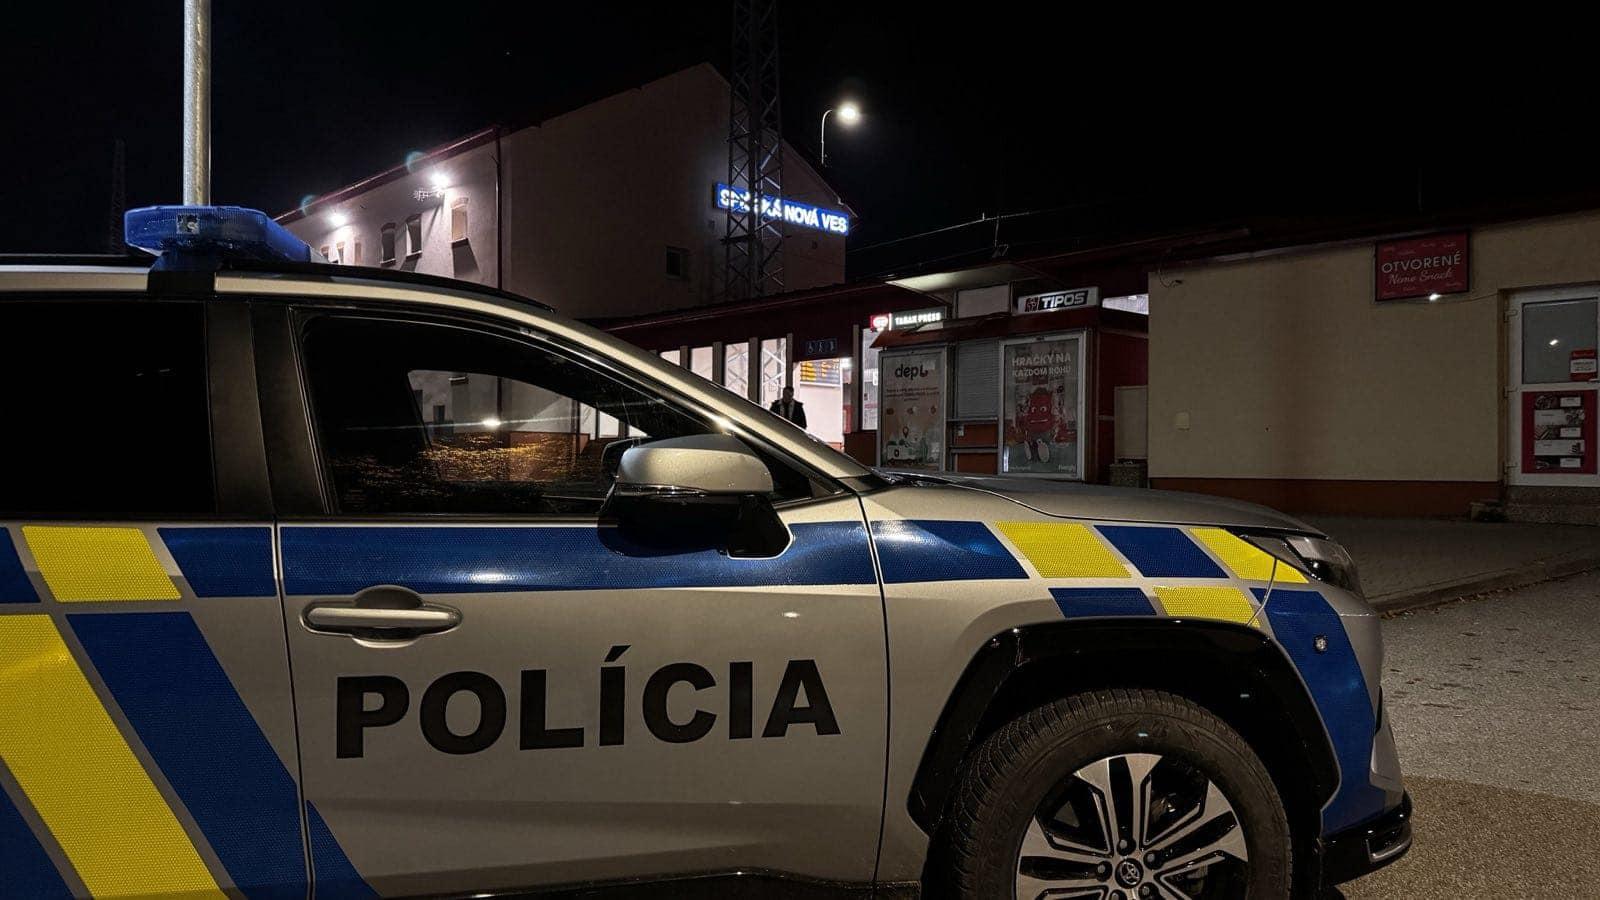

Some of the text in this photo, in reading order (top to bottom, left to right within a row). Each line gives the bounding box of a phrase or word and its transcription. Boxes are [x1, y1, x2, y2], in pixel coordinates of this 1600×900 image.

[784, 205, 819, 227] NOVÁ
[821, 213, 847, 233] VES
[1381, 250, 1461, 273] OTVORENÉ
[1041, 292, 1085, 308] TIPOS
[1056, 352, 1071, 364] NA
[336, 645, 841, 758] POLÍCIA
